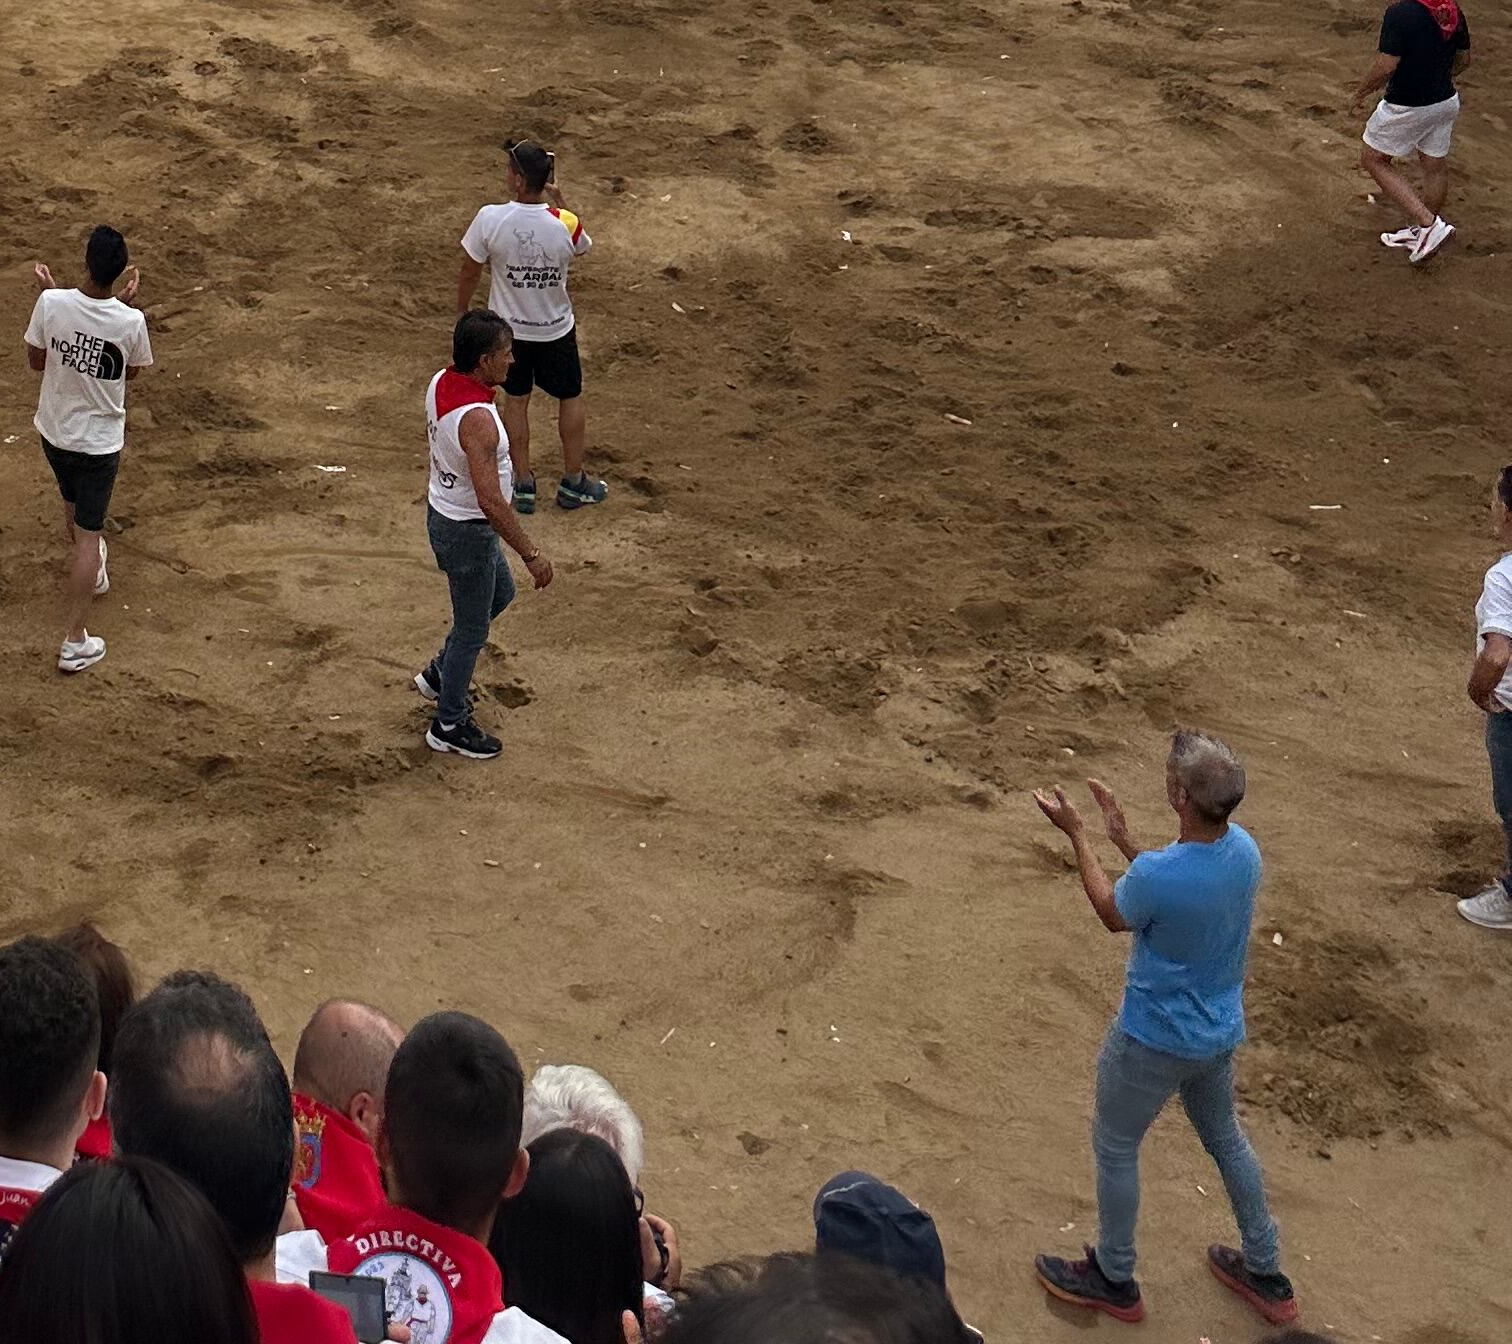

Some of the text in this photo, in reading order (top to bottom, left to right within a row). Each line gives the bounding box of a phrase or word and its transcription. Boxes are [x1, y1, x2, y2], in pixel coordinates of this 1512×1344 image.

[51, 336, 101, 363] NORTH
[73, 331, 104, 353] THE
[61, 353, 97, 379] FACE
[354, 1228, 463, 1290] DIRECTIVA
